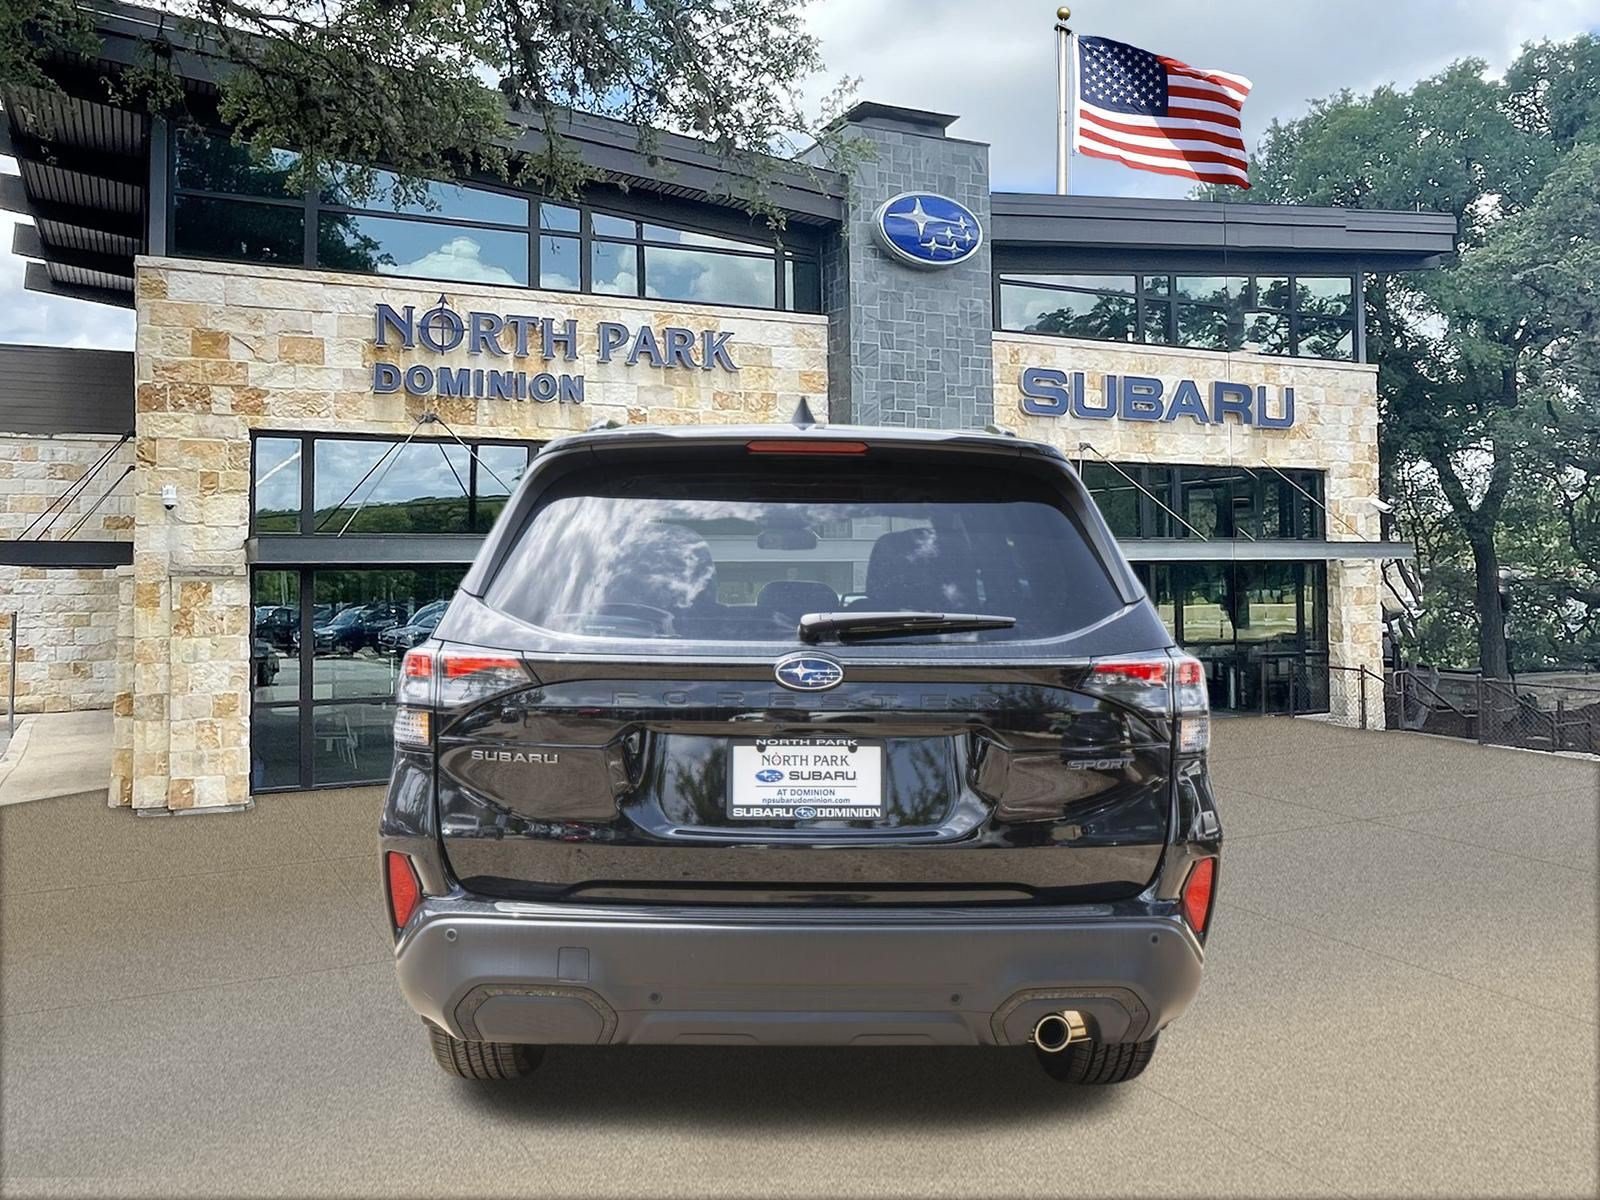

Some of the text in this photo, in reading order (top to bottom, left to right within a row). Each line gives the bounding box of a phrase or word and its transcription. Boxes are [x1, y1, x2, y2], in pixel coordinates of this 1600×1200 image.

[374, 294, 741, 373] NORTH PARK
[373, 361, 585, 404] DOMINION
[1018, 366, 1295, 430] SUBARU
[755, 738, 858, 746] NORTH PARK
[471, 750, 559, 764] SUBARU
[761, 753, 850, 767] NORTH PARK
[1066, 759, 1133, 770] SPORT
[788, 770, 857, 781] SUBARU
[776, 789, 836, 797] AT DOMINION
[762, 797, 851, 805] npsubarudominion.com
[732, 807, 881, 818] SUBARU DOMINION
